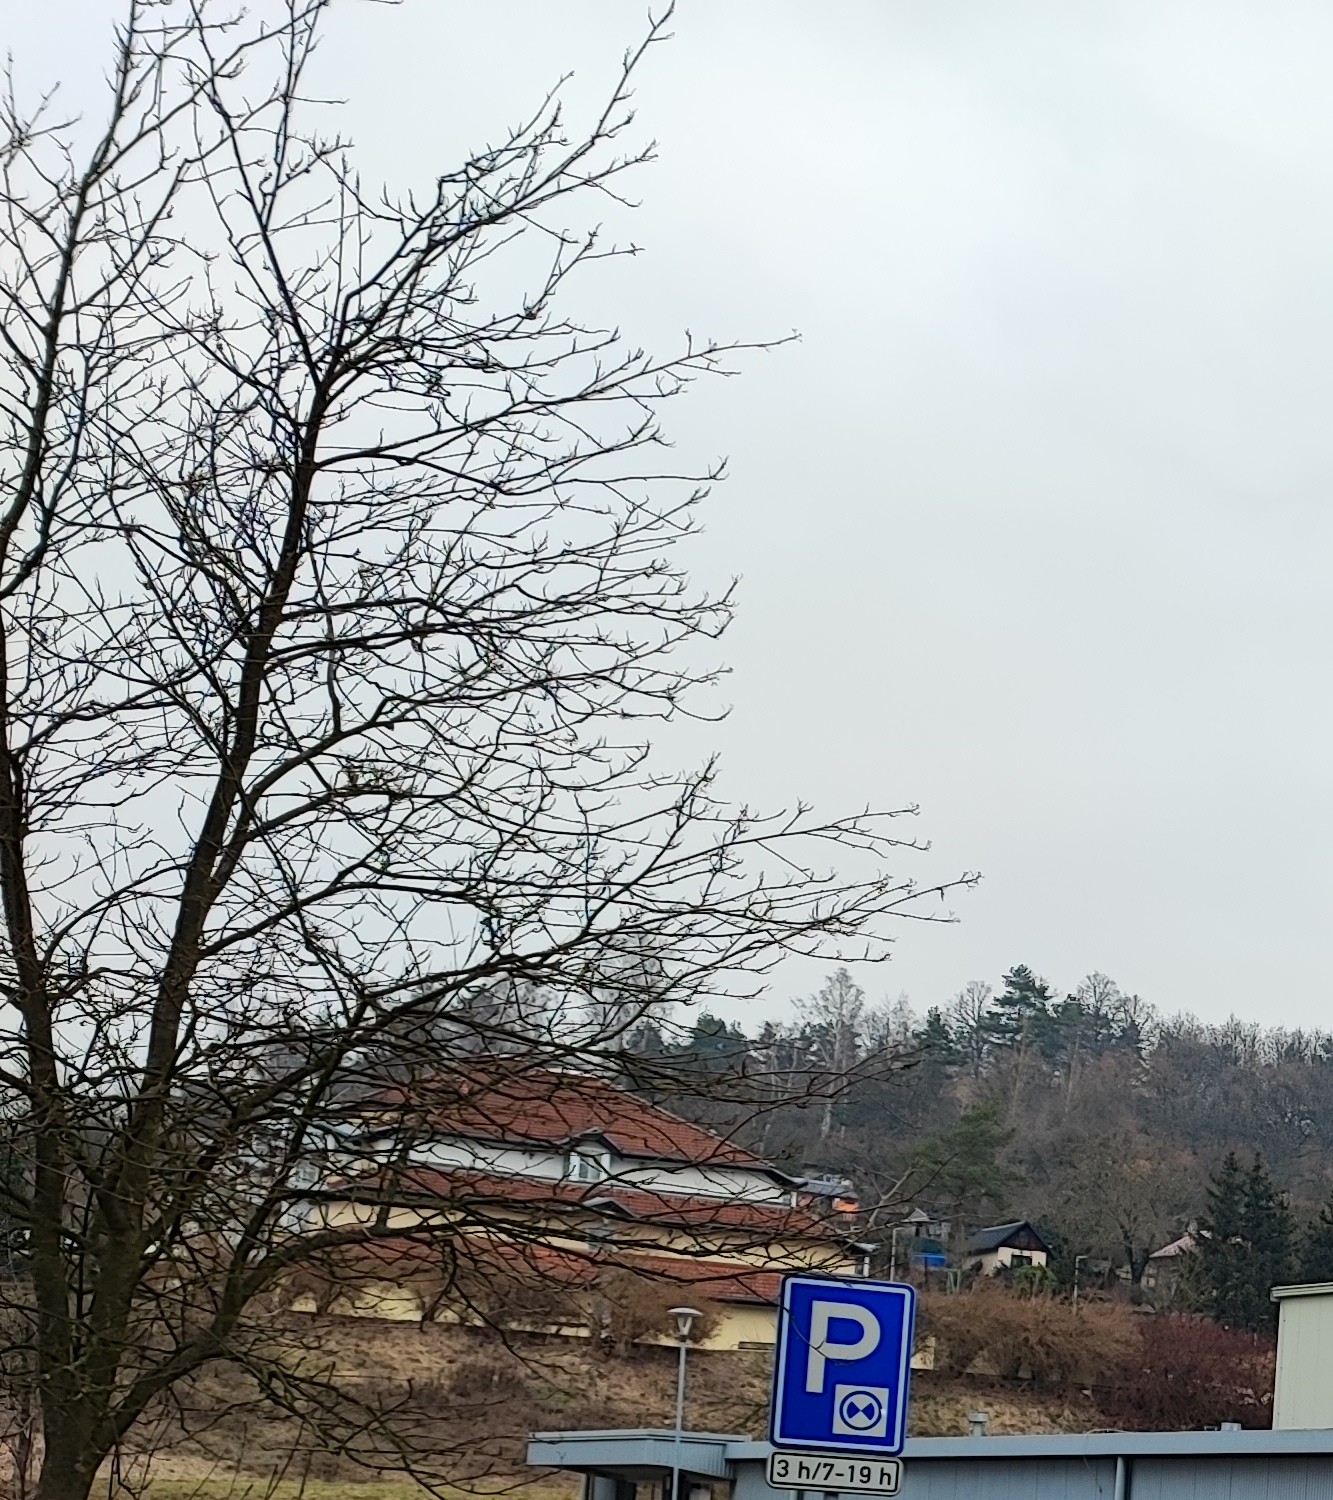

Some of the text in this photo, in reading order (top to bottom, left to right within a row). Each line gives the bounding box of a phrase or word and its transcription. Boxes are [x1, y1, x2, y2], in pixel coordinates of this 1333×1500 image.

[806, 1300, 881, 1393] P
[777, 1459, 789, 1478] 3
[879, 1466, 892, 1486] h
